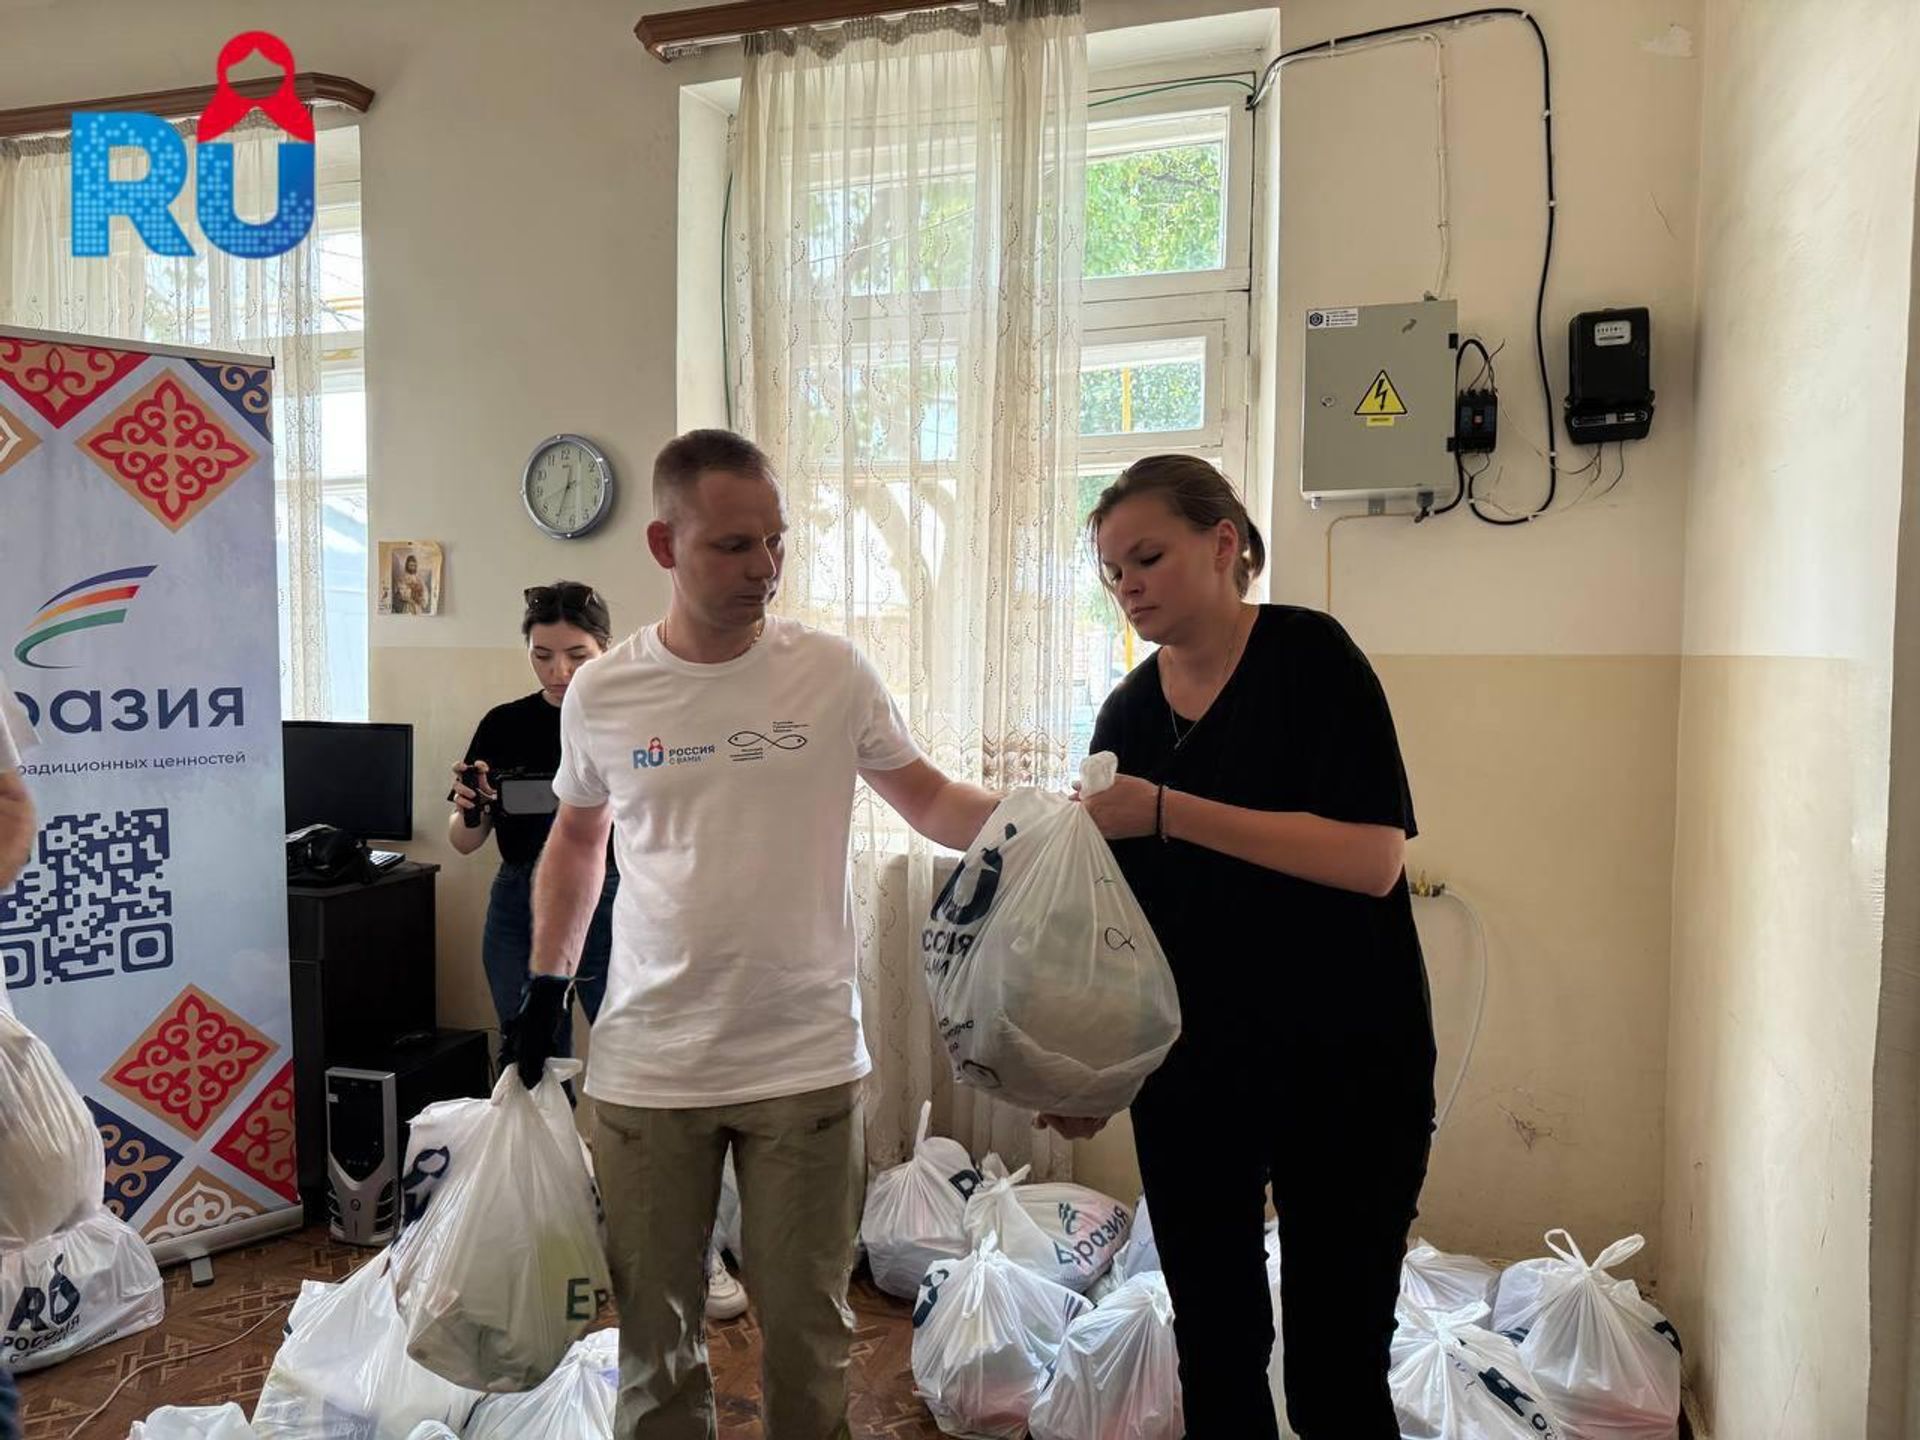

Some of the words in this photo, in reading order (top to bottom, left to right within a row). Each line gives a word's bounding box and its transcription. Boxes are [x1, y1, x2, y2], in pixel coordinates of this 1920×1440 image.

[561, 447, 570, 460] 12
[669, 744, 716, 757] РОССИЯ
[19, 756, 147, 777] радиционных
[153, 750, 246, 769] ценностей
